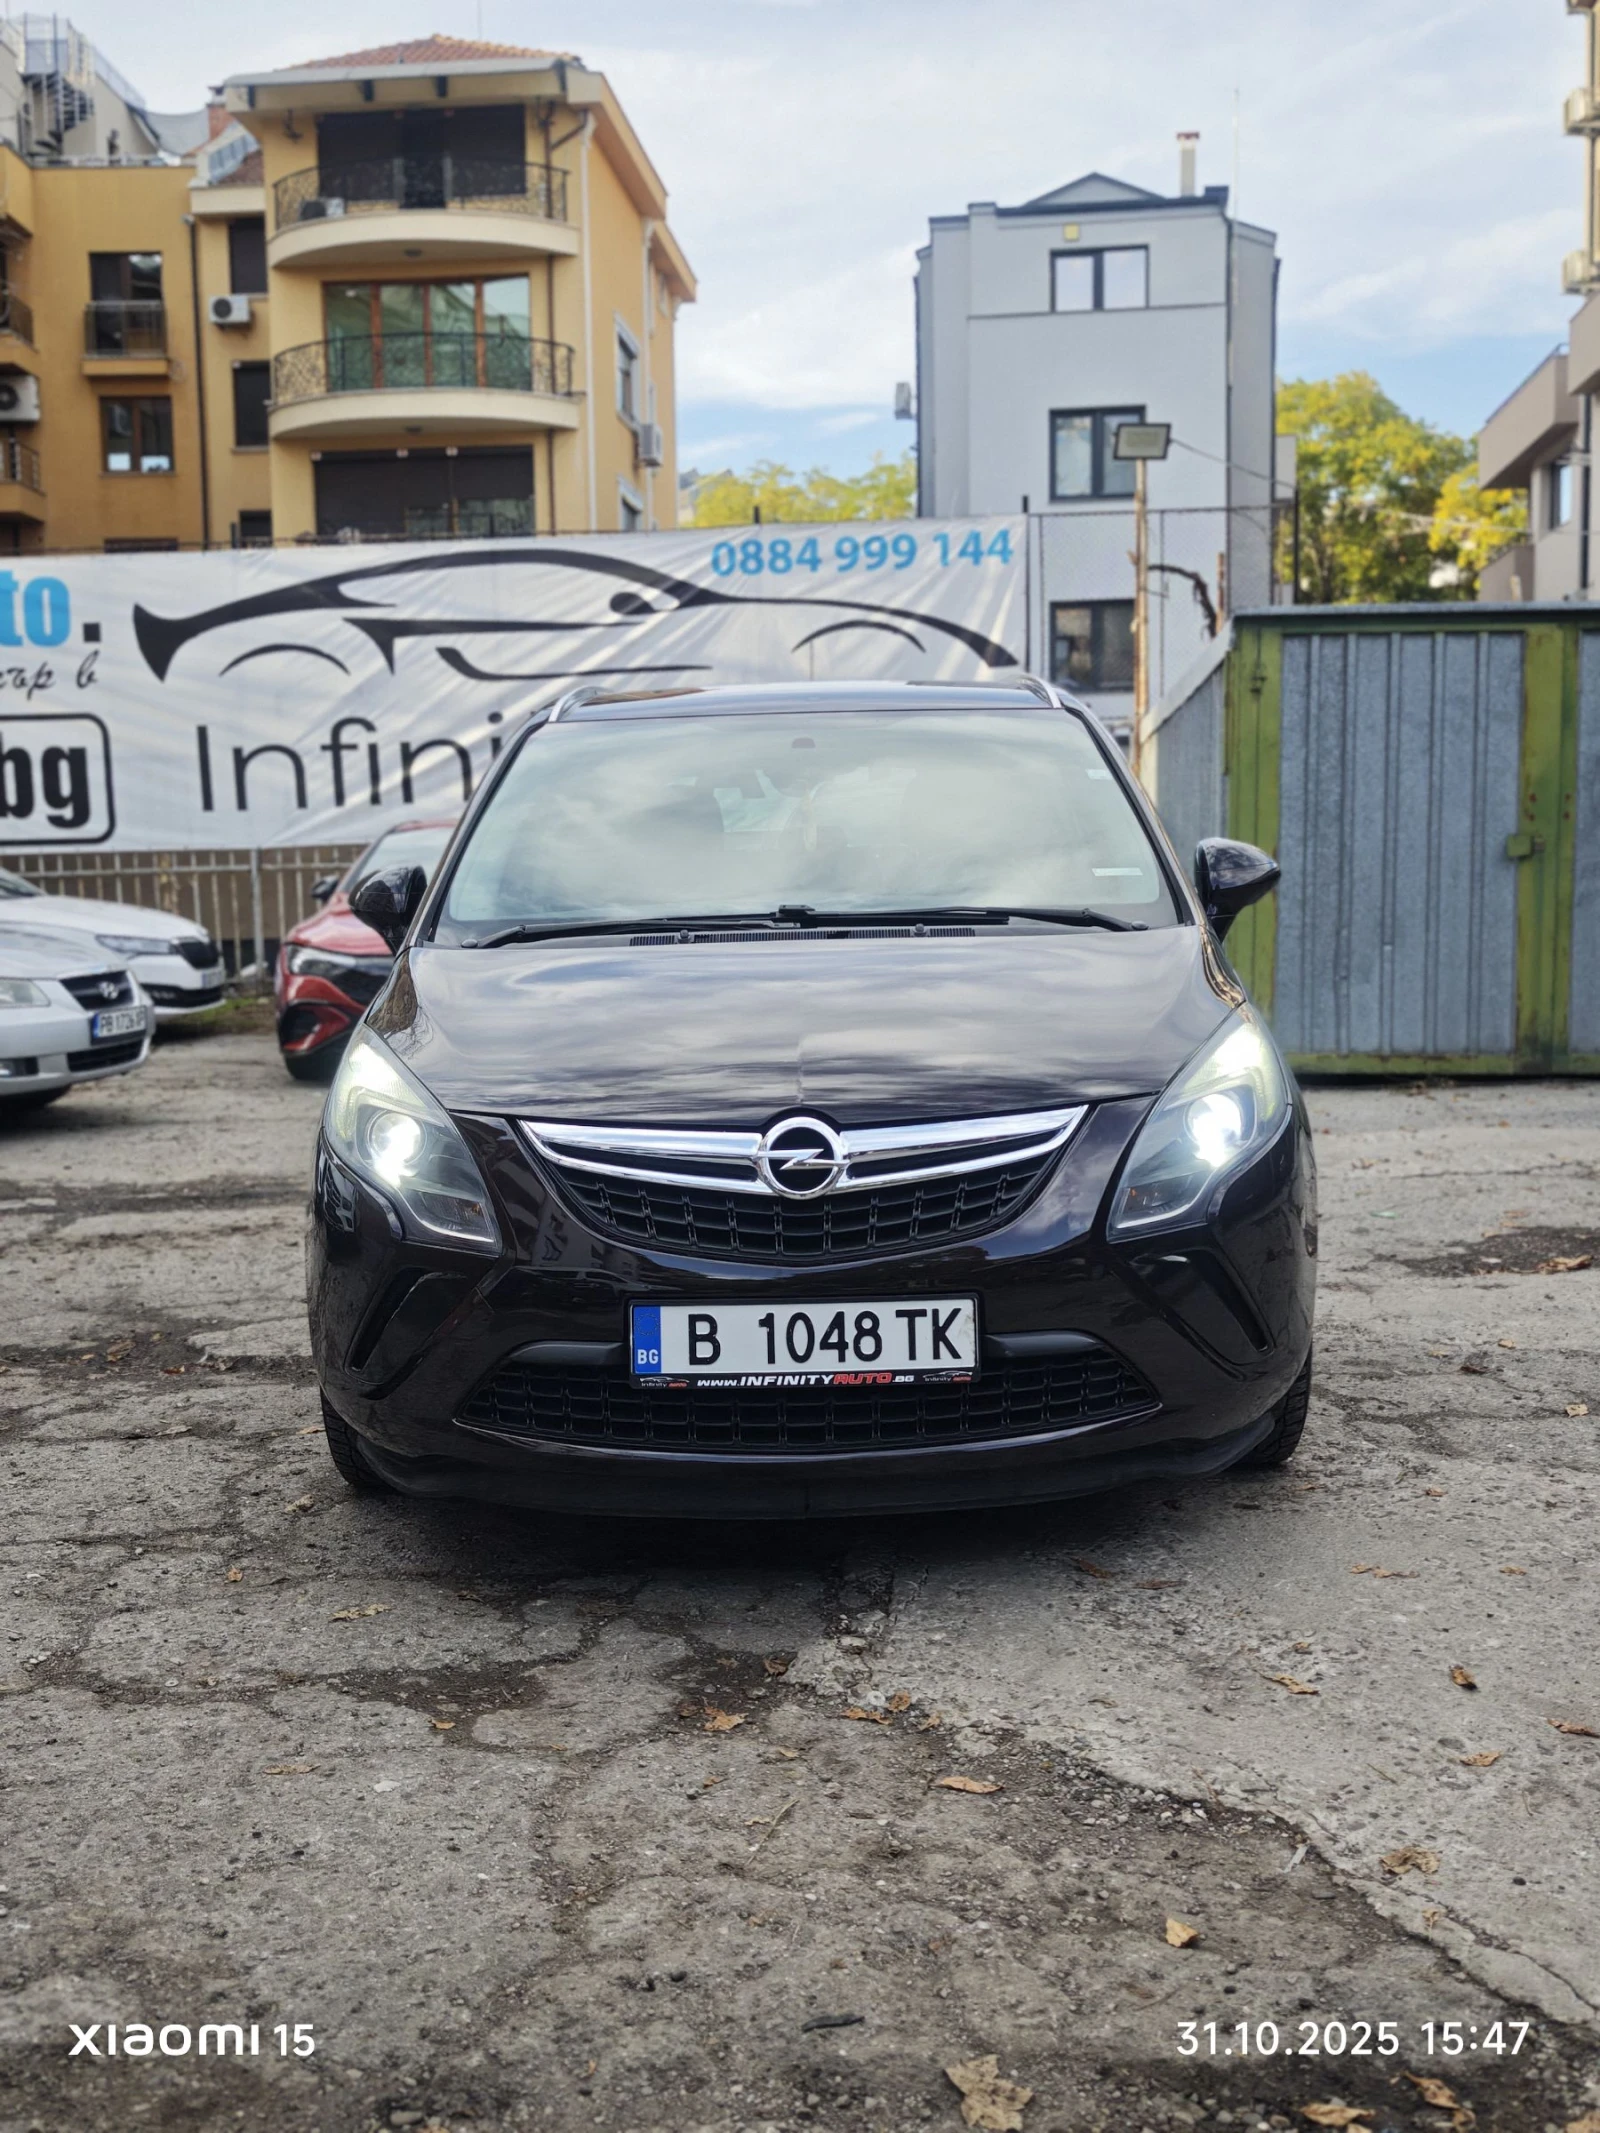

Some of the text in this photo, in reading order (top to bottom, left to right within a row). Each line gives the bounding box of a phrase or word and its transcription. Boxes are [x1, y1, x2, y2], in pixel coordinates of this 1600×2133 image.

[711, 528, 1014, 577] 0884 999 144
[637, 1348, 659, 1365] BG
[688, 1308, 962, 1365] B 1048 TK
